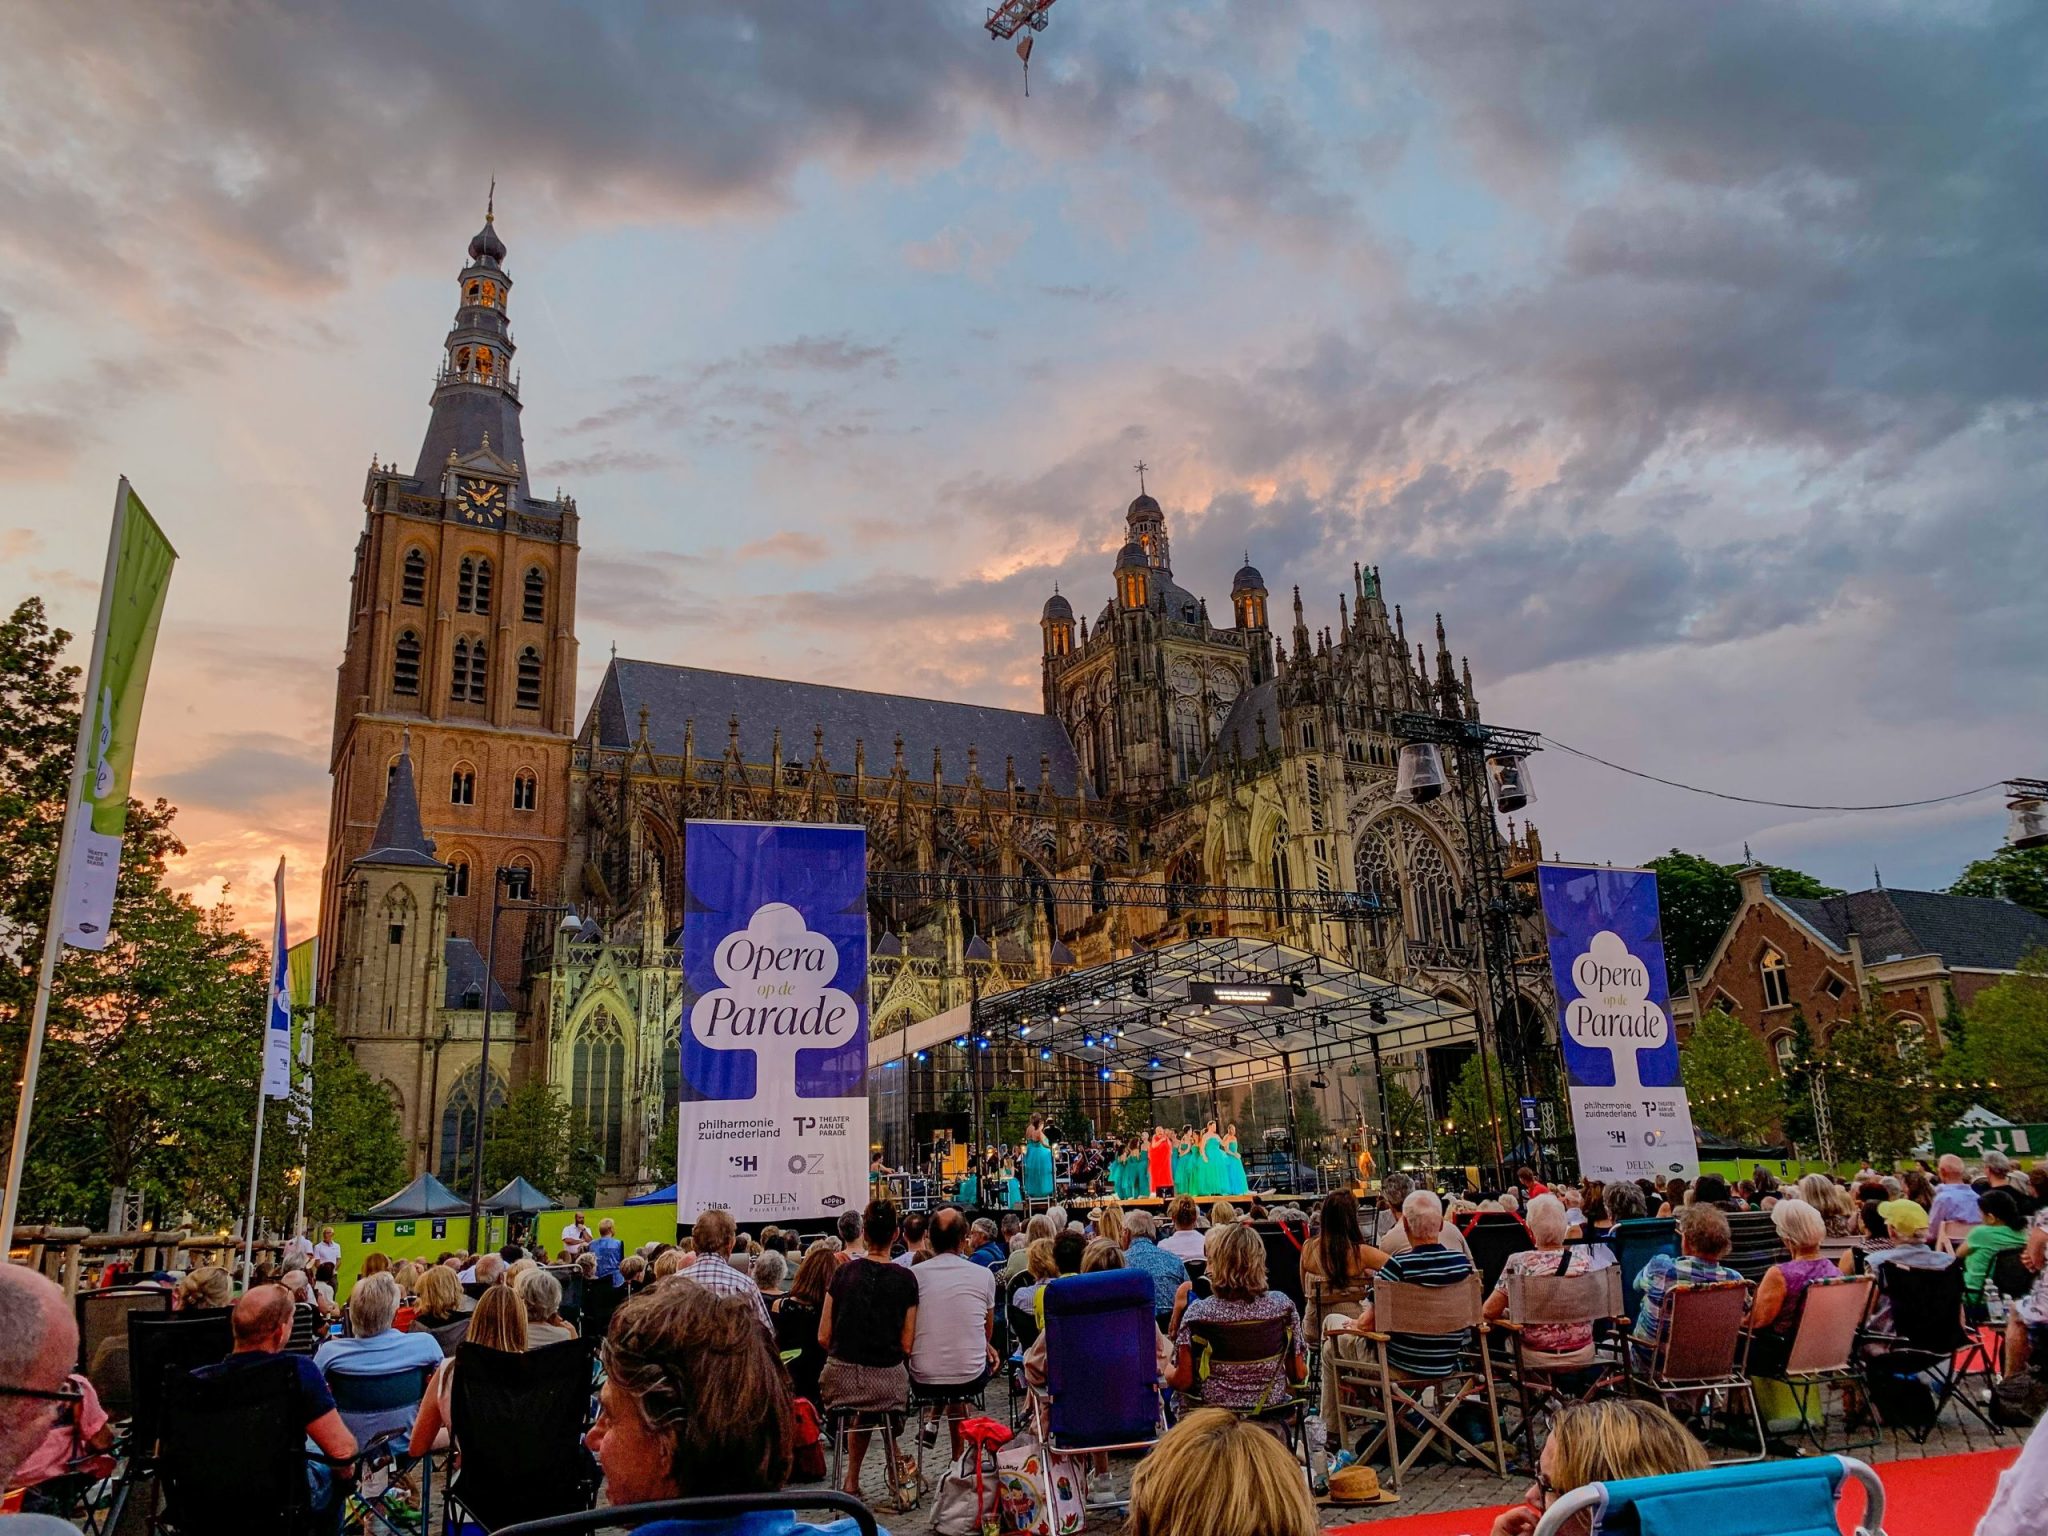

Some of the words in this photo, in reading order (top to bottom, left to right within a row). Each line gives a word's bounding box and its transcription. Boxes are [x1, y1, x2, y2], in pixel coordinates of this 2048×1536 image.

[726, 939, 825, 980] Opera
[1580, 959, 1642, 992] Opera
[757, 985, 775, 999] op
[778, 980, 796, 996] de
[704, 995, 847, 1037] Parade
[1576, 1005, 1660, 1038] Parade
[1584, 1110, 1638, 1118] zuidnederland
[698, 1117, 774, 1132] philharmonie
[835, 1122, 845, 1130] DE
[698, 1128, 781, 1141] zuidnederland
[818, 1129, 847, 1137] PARADE
[1626, 1160, 1655, 1170] DELEN
[752, 1192, 798, 1206] DELEN
